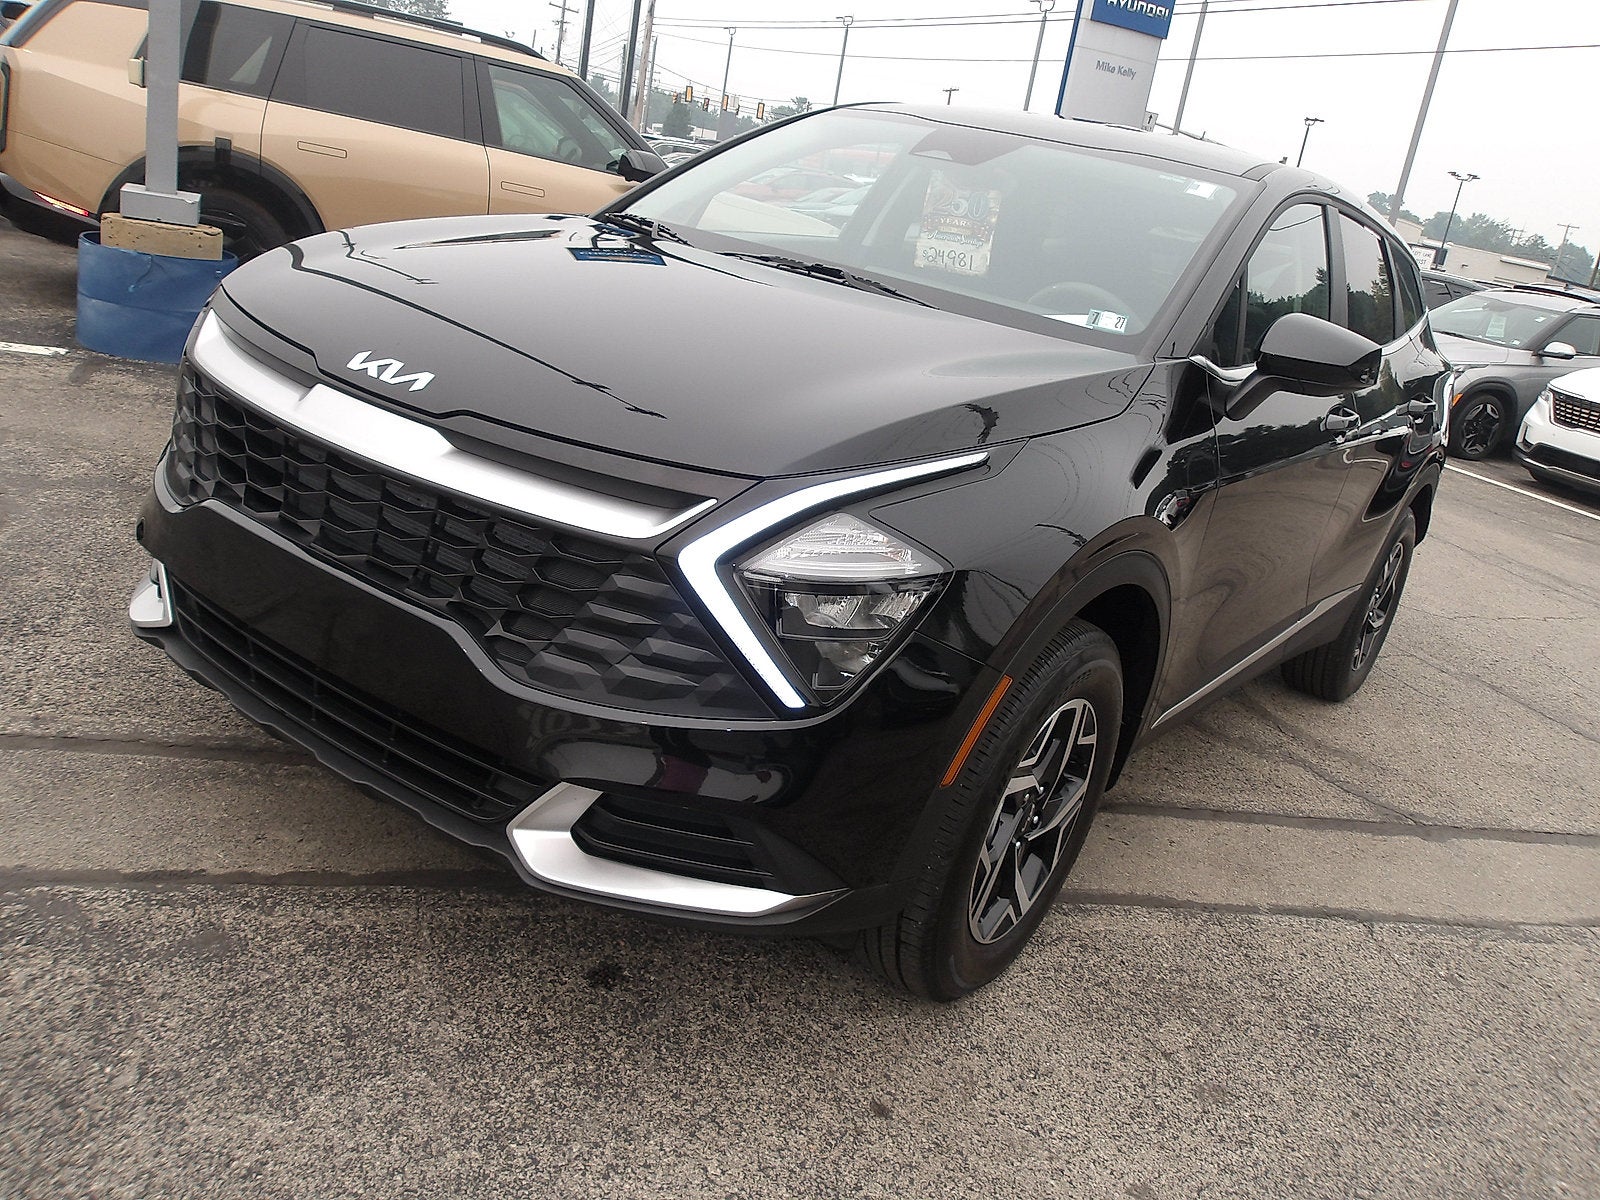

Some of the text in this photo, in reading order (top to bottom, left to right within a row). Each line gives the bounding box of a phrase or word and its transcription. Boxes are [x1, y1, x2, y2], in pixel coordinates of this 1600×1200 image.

[1095, 60, 1136, 80] Mike Kelly
[1092, 311, 1126, 329] 7 27
[346, 349, 436, 392] KIA
